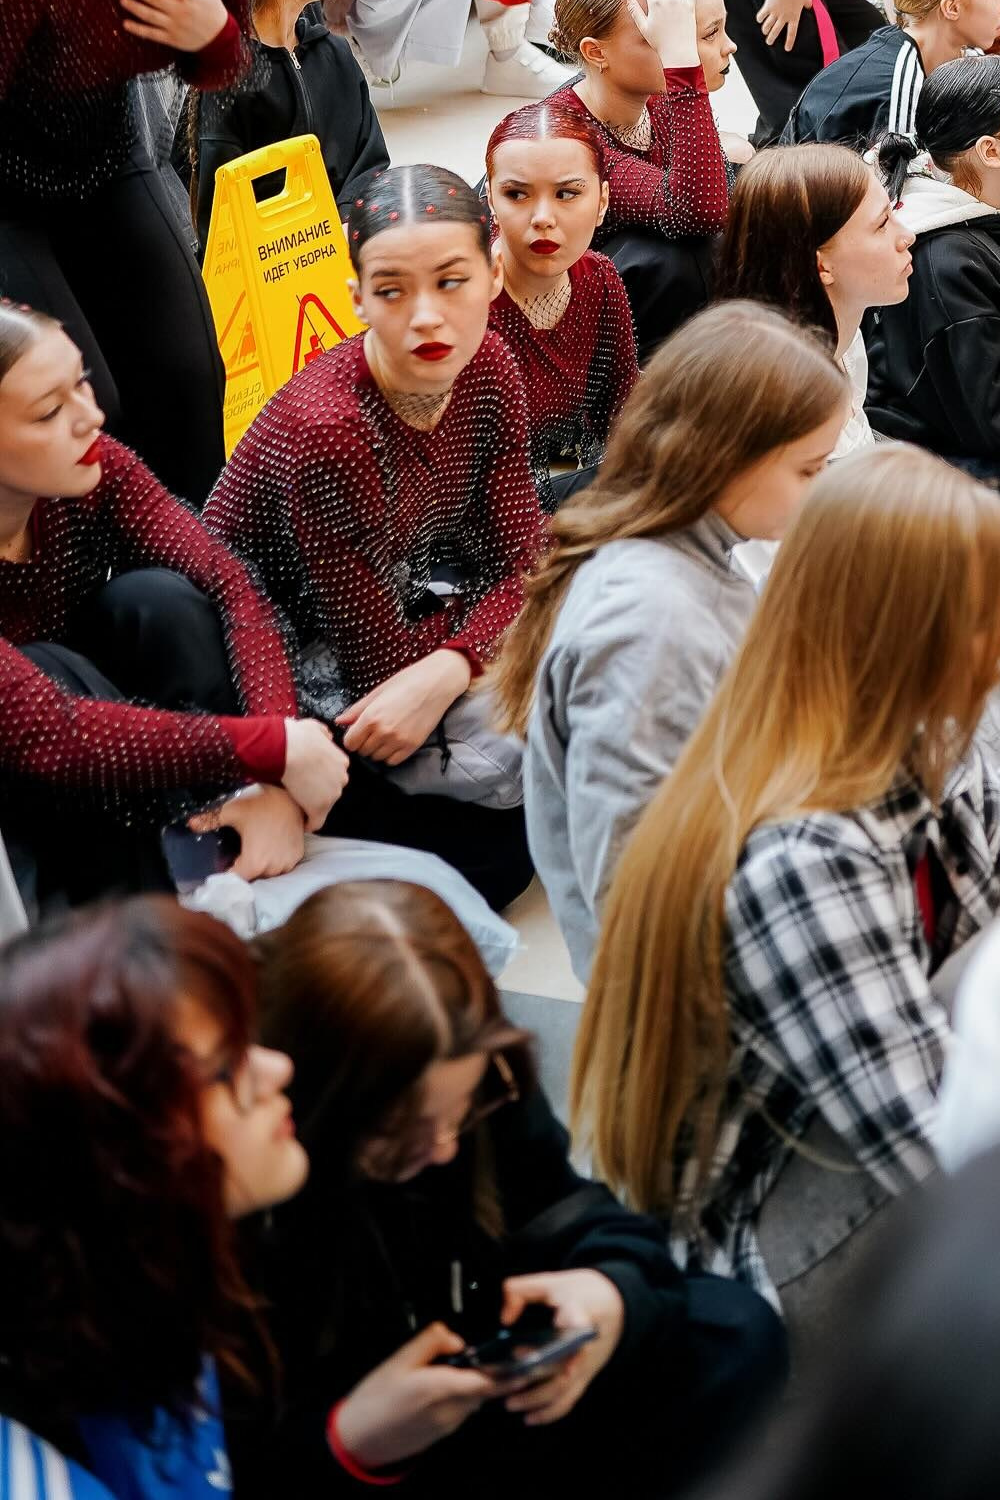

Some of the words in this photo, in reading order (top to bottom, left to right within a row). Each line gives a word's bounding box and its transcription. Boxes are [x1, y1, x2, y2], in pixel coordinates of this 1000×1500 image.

[258, 220, 332, 261] ВНИМАНИЕ
[263, 261, 291, 283] ИДЁТ
[293, 243, 337, 272] УБОРКА
